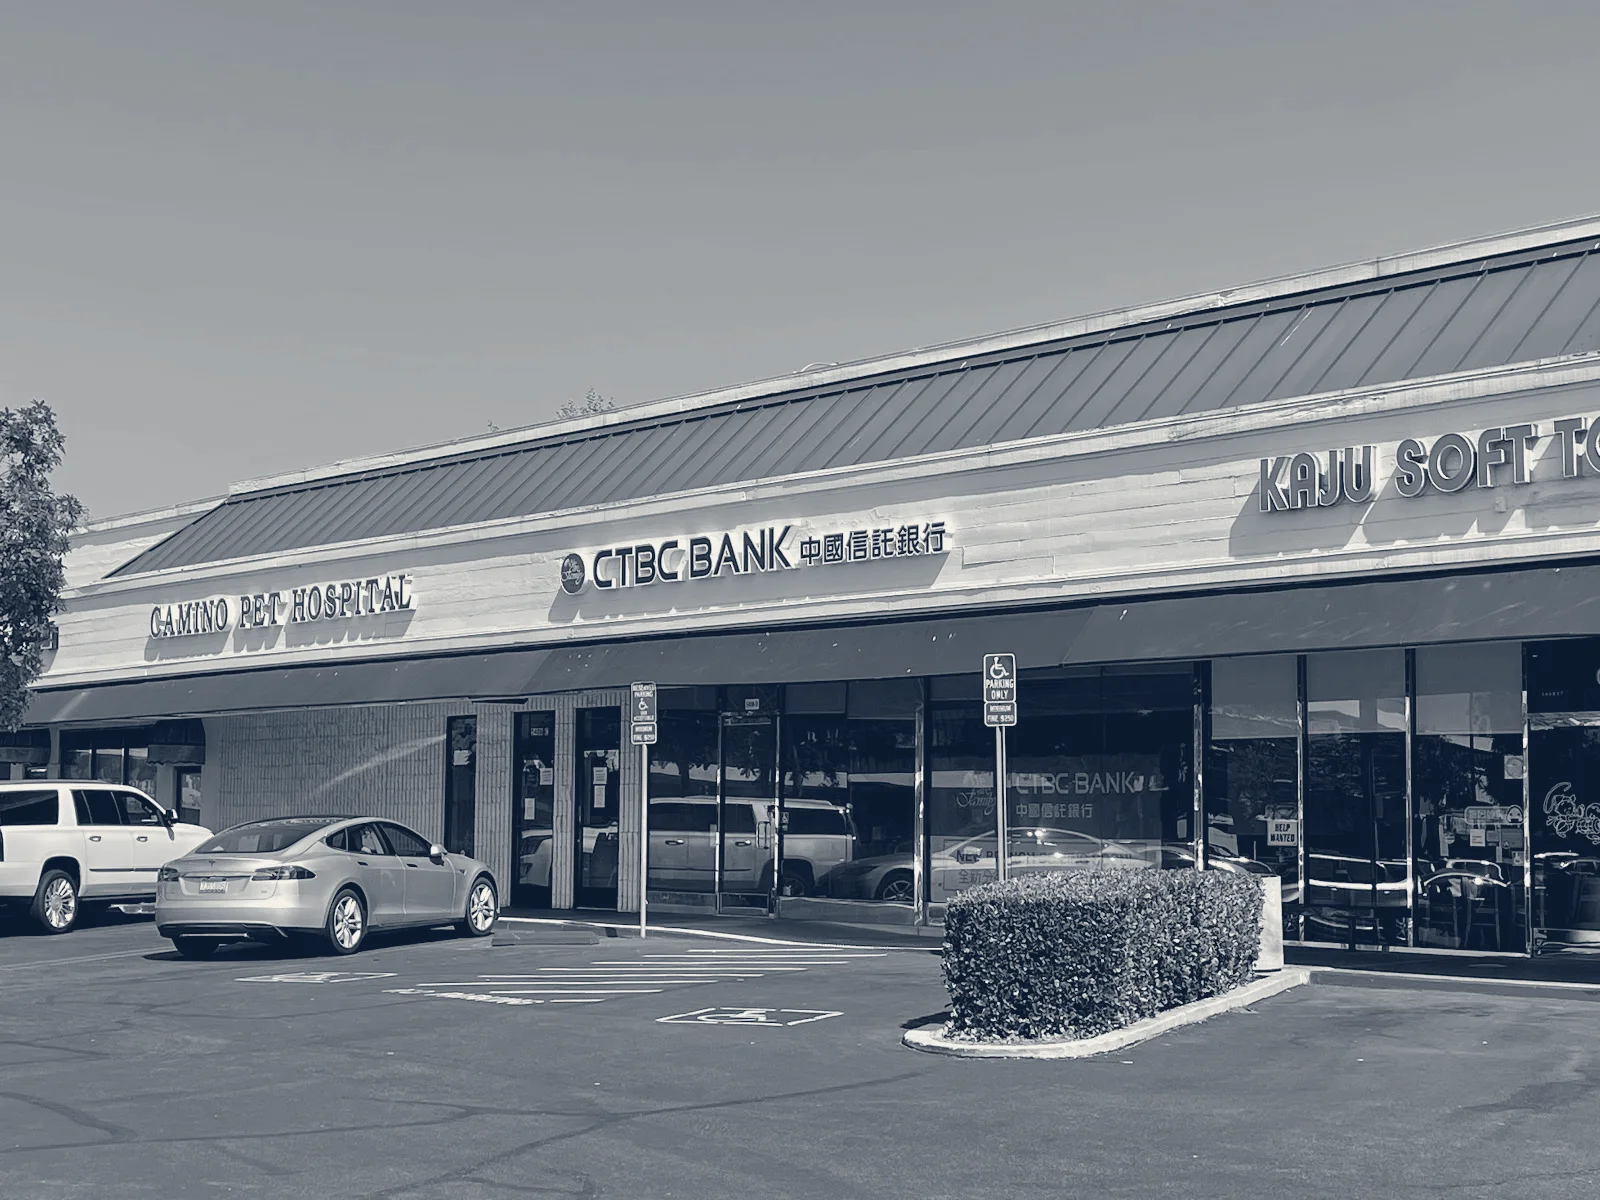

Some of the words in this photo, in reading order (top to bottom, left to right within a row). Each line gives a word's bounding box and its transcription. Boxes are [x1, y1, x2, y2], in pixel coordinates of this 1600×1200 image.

[1259, 446, 1374, 512] KAJU
[1396, 424, 1533, 498] SOFT
[1553, 417, 1600, 478] T
[799, 521, 947, 566] 中國信託銀行
[593, 541, 678, 589] CTBC
[689, 525, 794, 580] BANK
[150, 599, 228, 638] CAMINO
[240, 593, 283, 628] PET
[292, 575, 413, 623] HOSPITAL
[985, 679, 1014, 689] PARKING
[991, 690, 1008, 700] ONLY
[1074, 771, 1135, 794] BANK
[1270, 833, 1296, 843] WANTED
[1274, 823, 1291, 832] HELP
